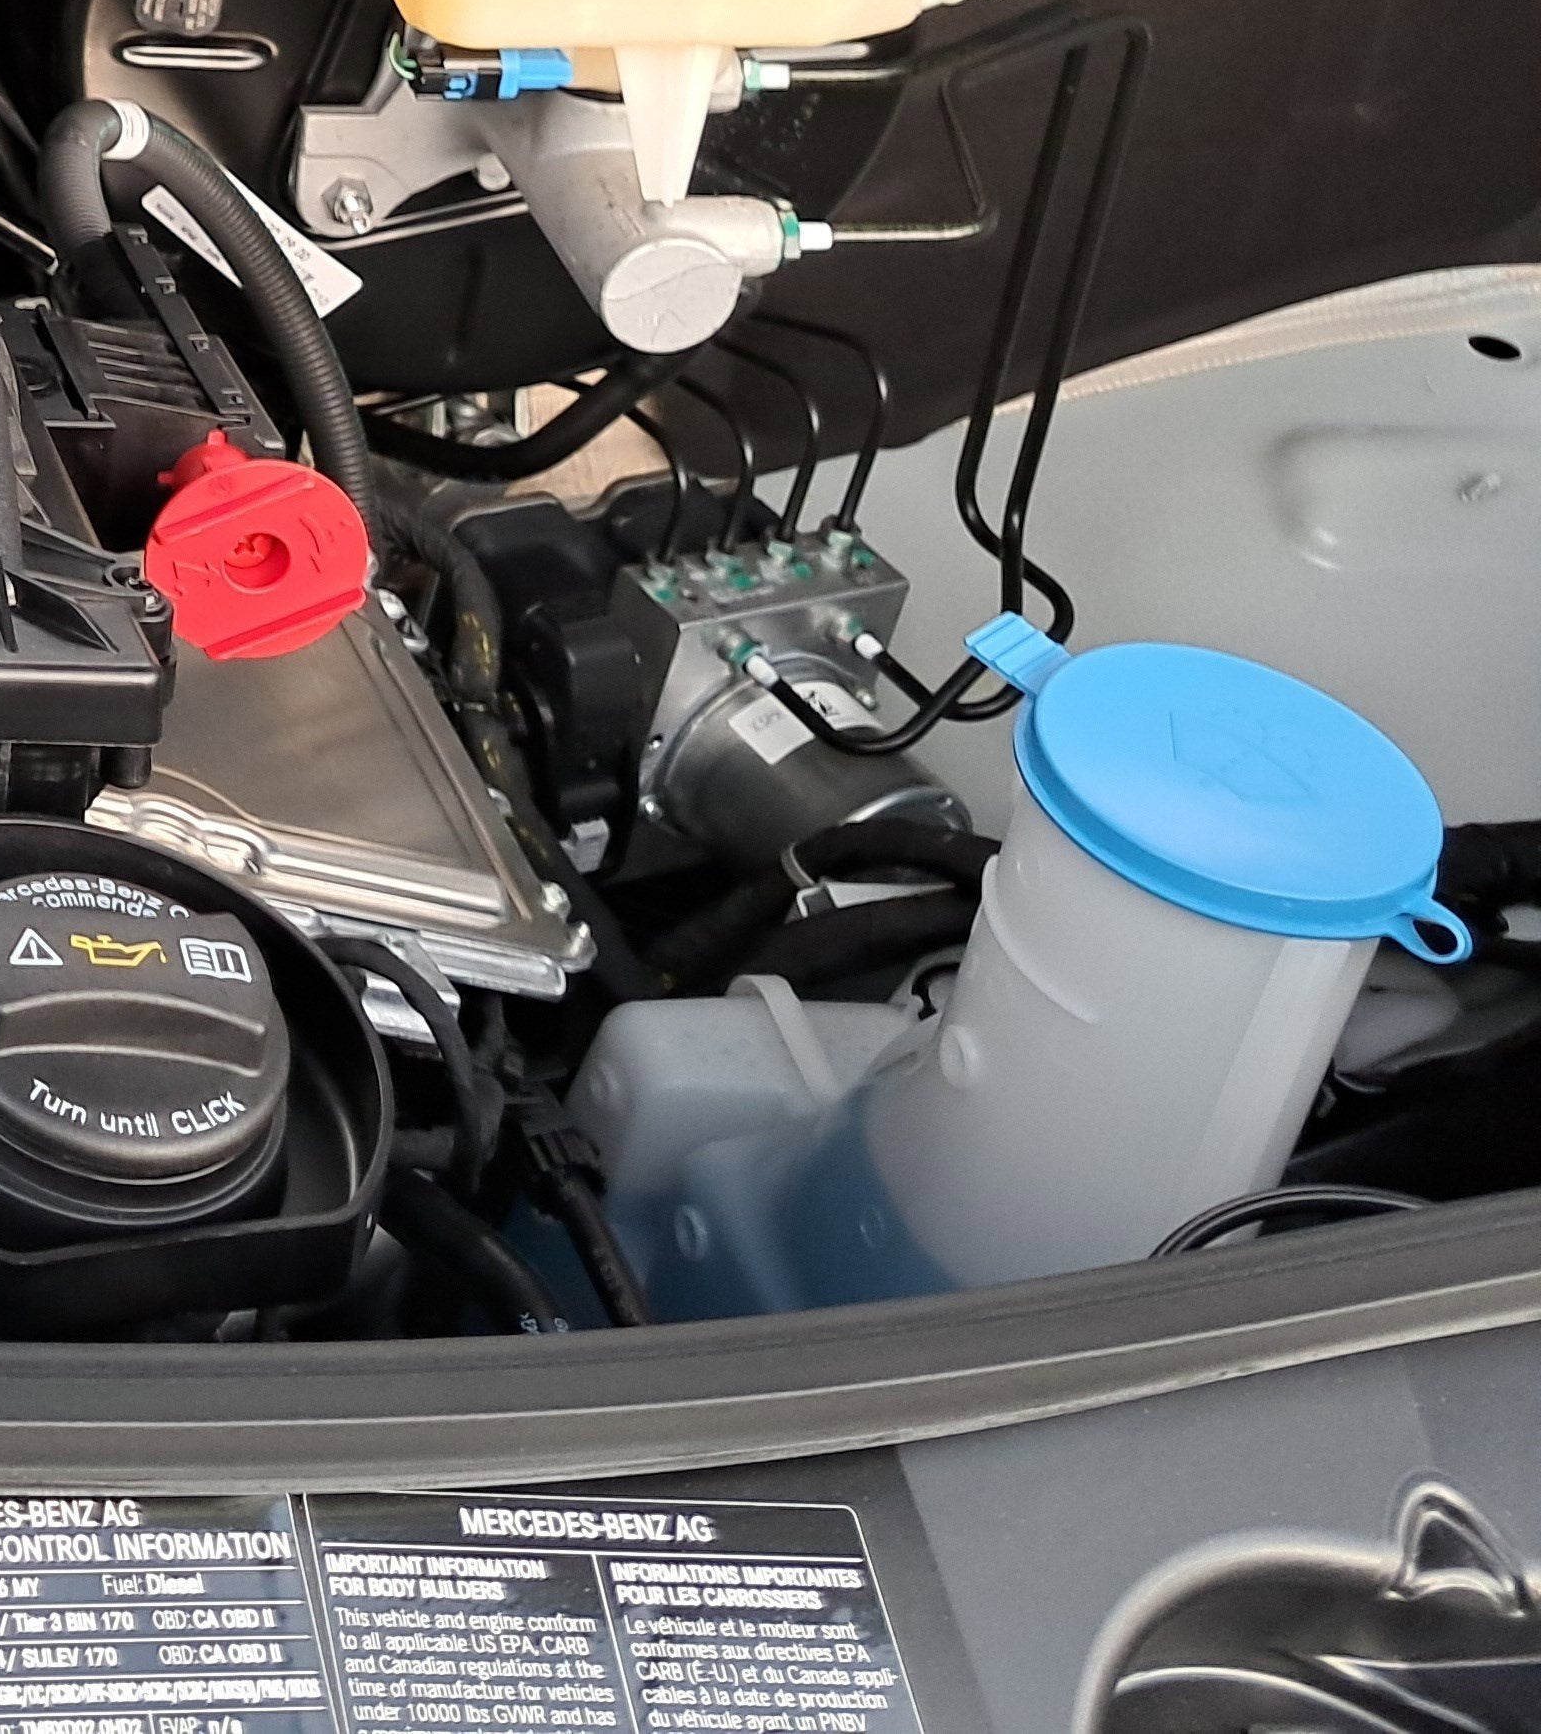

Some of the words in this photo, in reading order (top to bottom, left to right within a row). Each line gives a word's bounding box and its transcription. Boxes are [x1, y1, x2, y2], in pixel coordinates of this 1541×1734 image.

[29, 1078, 87, 1126] Turn
[100, 1111, 160, 1138] until
[171, 1090, 247, 1136] CLICK
[103, 1499, 141, 1527] AG
[460, 1508, 673, 1541] MERCEDES-BENZ
[676, 1515, 713, 1542] AG
[113, 1531, 291, 1562] INFORMATION
[325, 1554, 425, 1575] IMPORTANT
[428, 1557, 547, 1579] INFORMATION
[610, 1563, 741, 1584] INFORMATIONS
[743, 1566, 863, 1588] IMPORTANTES
[12, 1576, 40, 1598] MY
[103, 1575, 143, 1596] Fuel:
[145, 1573, 206, 1595] Diesel
[329, 1577, 366, 1596] FOR
[369, 1579, 416, 1598] BODY
[420, 1580, 506, 1600] BUILDERS
[617, 1586, 668, 1605] POUR
[670, 1587, 701, 1606] LES
[703, 1588, 823, 1609] CARROSSIERS
[15, 1613, 47, 1633] Tier
[50, 1612, 62, 1633] 3
[66, 1612, 98, 1632] BIN
[101, 1611, 135, 1632] 170
[152, 1610, 191, 1631] OBD:
[195, 1610, 219, 1630] CA
[223, 1609, 260, 1629] OBD
[334, 1607, 369, 1626] This
[373, 1609, 430, 1627] vehicle
[435, 1611, 465, 1628] and
[469, 1612, 523, 1634] engine
[528, 1614, 597, 1632] conform
[624, 1616, 646, 1634] Le
[649, 1617, 717, 1636] véhicule
[721, 1619, 737, 1637] et
[741, 1620, 755, 1637] le
[761, 1621, 817, 1639] moteur
[822, 1623, 860, 1640] sont
[21, 1648, 79, 1669] SULEV
[84, 1647, 119, 1667] 170
[159, 1646, 199, 1666] OBD:
[199, 1645, 225, 1665] CA
[229, 1645, 267, 1664] OBD
[341, 1632, 357, 1650] to
[363, 1632, 381, 1650] all
[386, 1633, 467, 1656] applicable
[472, 1634, 497, 1653] US
[501, 1635, 539, 1657] EPA,
[542, 1636, 590, 1656] CARB
[631, 1640, 717, 1659] conformes
[723, 1646, 751, 1660] aux
[754, 1642, 832, 1662] directives
[835, 1644, 871, 1663] EPA
[345, 1656, 376, 1674] and
[379, 1657, 457, 1676] Canadian
[460, 1659, 553, 1681] regulations
[556, 1661, 572, 1678] at
[576, 1661, 605, 1679] the
[636, 1662, 685, 1682] CARB
[742, 1665, 760, 1683] et
[763, 1666, 784, 1684] du
[787, 1666, 851, 1685] Canada
[853, 1669, 899, 1690] appli-
[349, 1678, 387, 1697] time
[390, 1679, 407, 1698] of
[411, 1681, 515, 1700] manufacture
[519, 1682, 542, 1701] for
[546, 1683, 615, 1703] vehicles
[643, 1687, 697, 1705] cables
[715, 1688, 731, 1706] la
[734, 1689, 768, 1707] date
[775, 1689, 795, 1707] de
[799, 1690, 888, 1712] production
[353, 1705, 400, 1722] under
[407, 1706, 461, 1723] 10000
[465, 1707, 490, 1723] lbs
[494, 1707, 547, 1724] GVWR
[550, 1709, 582, 1725] and
[586, 1709, 616, 1726] has
[649, 1709, 671, 1728] du
[675, 1710, 742, 1729] véhicule
[747, 1712, 791, 1734] ayant
[795, 1716, 817, 1731] un
[820, 1713, 867, 1732] PNBV
